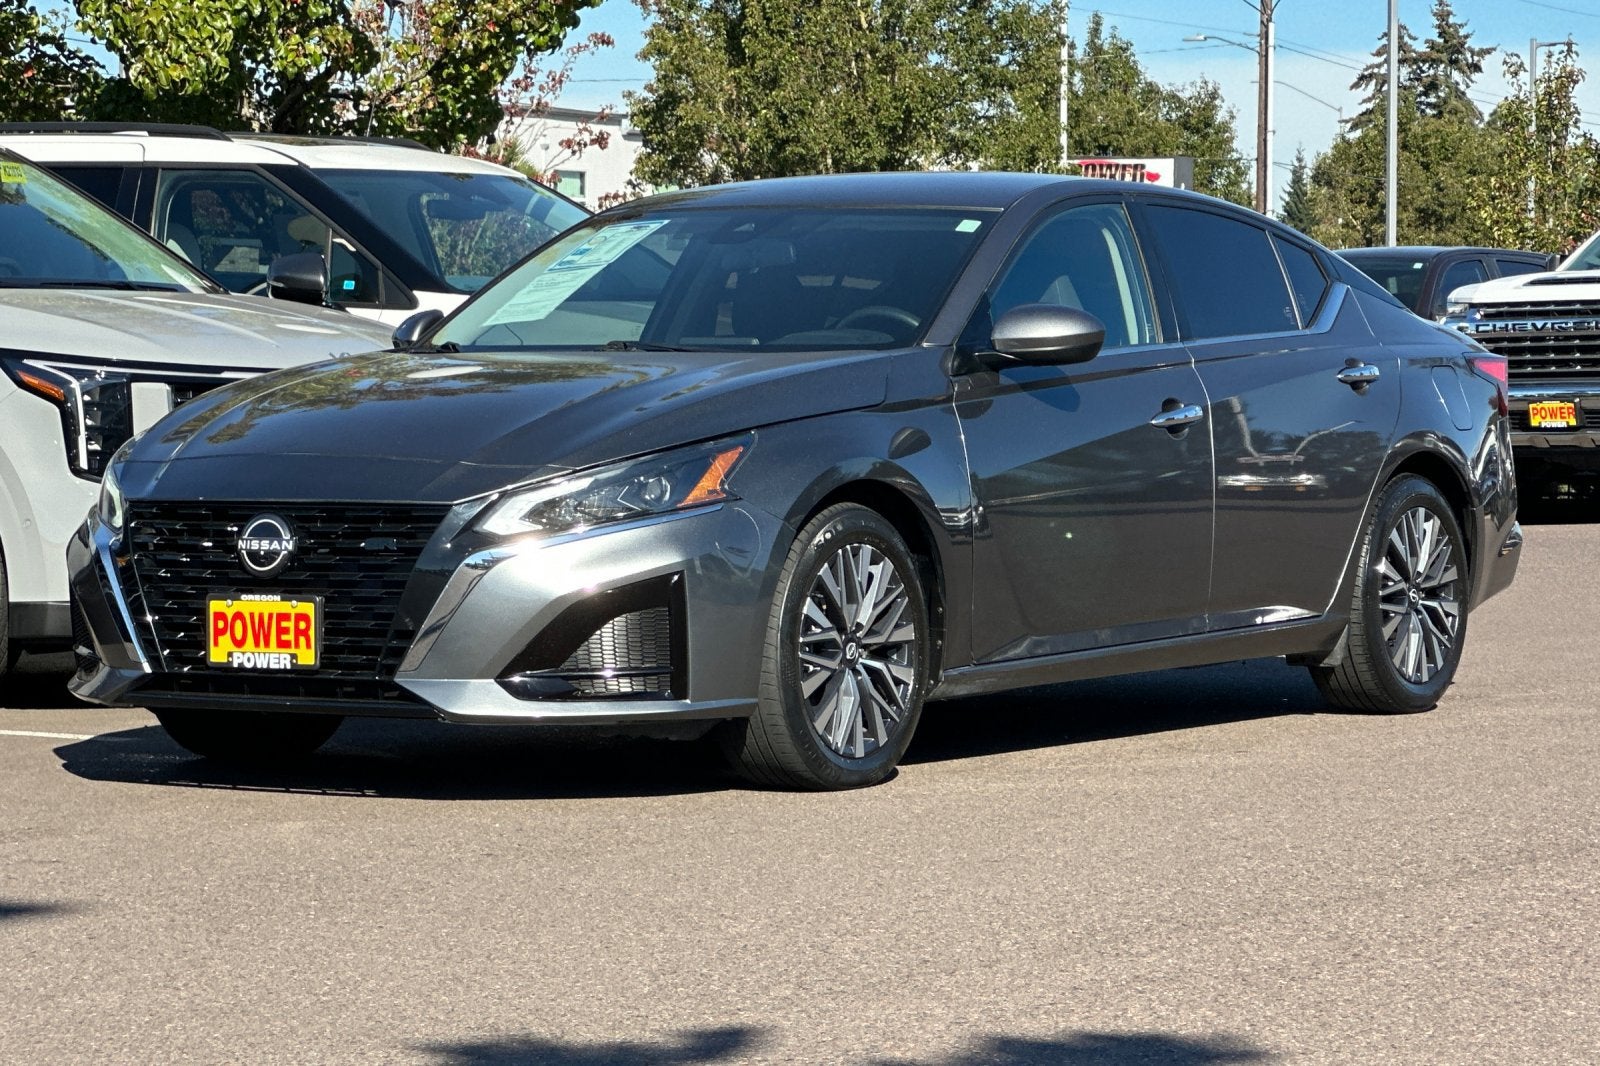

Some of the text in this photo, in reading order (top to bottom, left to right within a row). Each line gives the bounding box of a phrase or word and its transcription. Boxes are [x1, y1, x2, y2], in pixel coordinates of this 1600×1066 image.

[1078, 160, 1146, 183] OWER
[1531, 406, 1576, 420] POWER
[238, 539, 293, 550] NISSAN
[240, 594, 281, 602] OREGON
[212, 611, 312, 650] POWER
[232, 652, 292, 670] POWER
